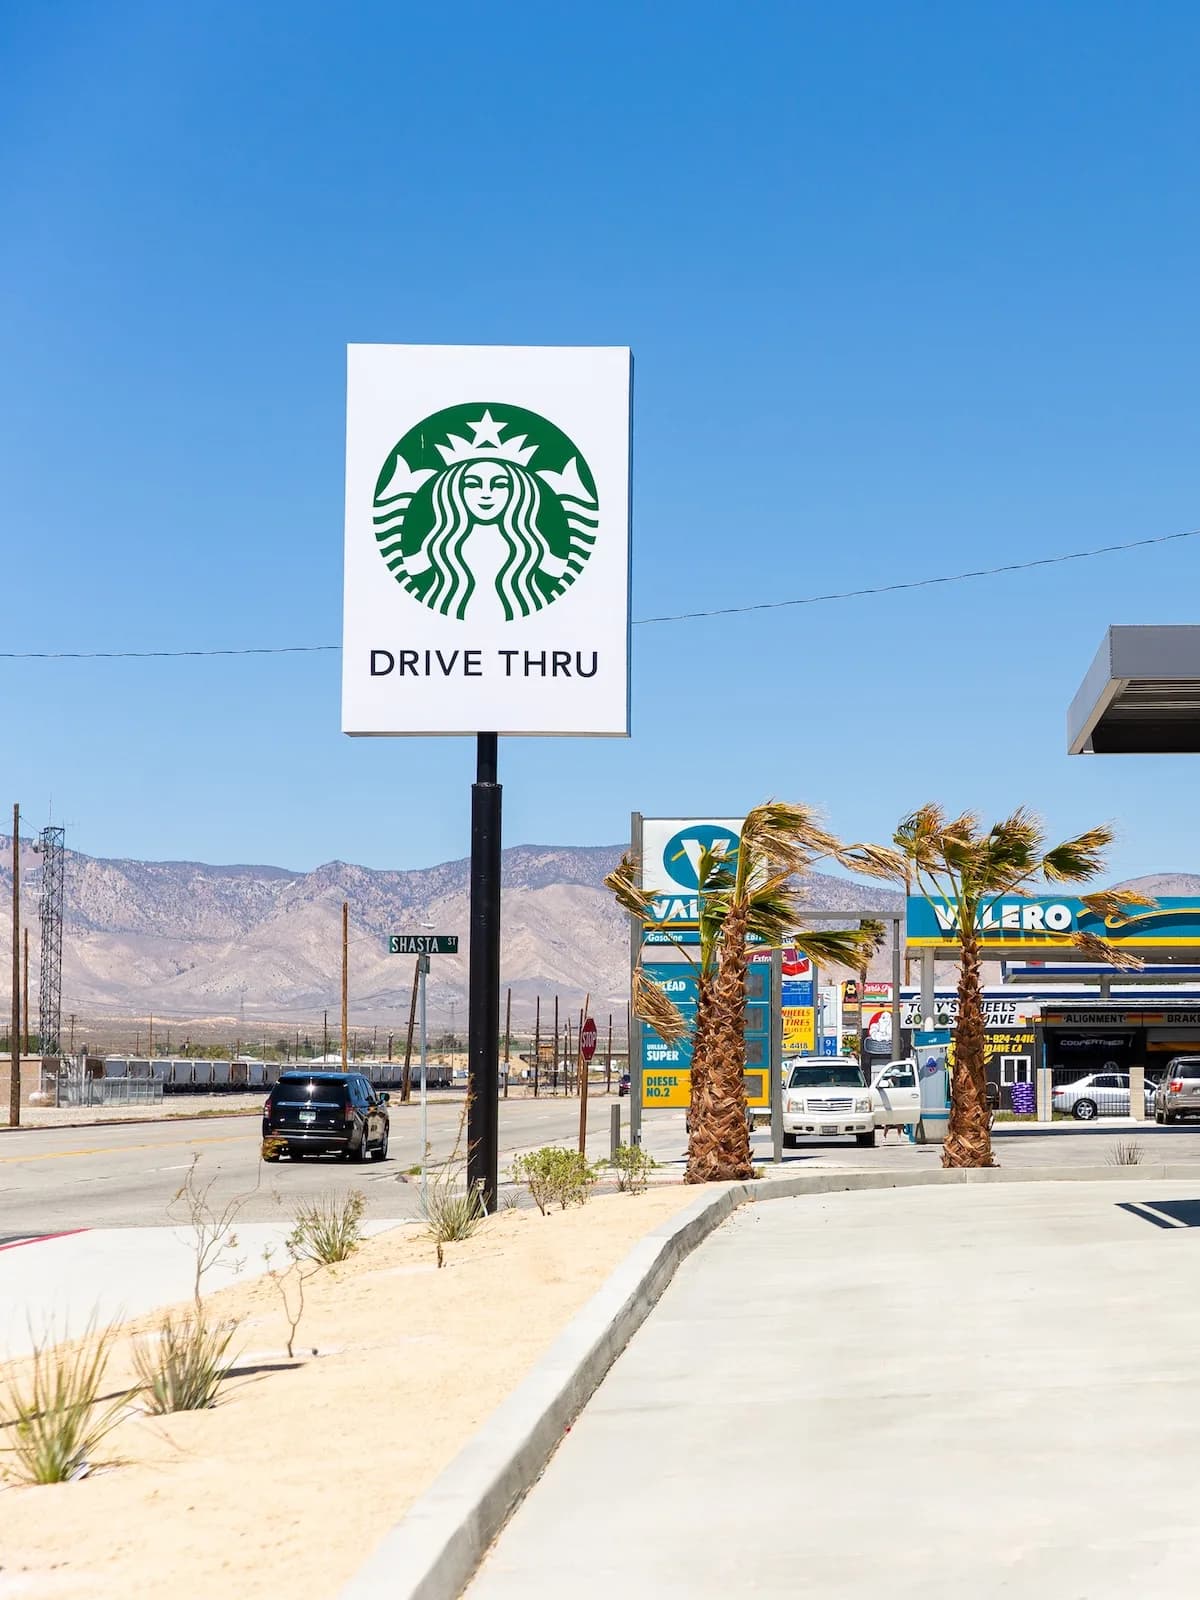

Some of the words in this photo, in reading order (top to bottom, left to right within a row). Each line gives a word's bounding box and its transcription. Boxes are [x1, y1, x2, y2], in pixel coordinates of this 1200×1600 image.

[370, 650, 483, 676] DRIVE
[498, 650, 598, 677] THRU
[934, 904, 1072, 931] VLERO
[391, 937, 439, 953] SHASTA
[447, 937, 456, 946] ST
[908, 1003, 957, 1013] TY'S
[785, 1018, 810, 1026] TIRES
[983, 1014, 1015, 1024] JAVE
[1065, 1014, 1122, 1023] ALIGNMENT
[582, 1031, 596, 1048] STOP
[646, 1050, 679, 1061] SUPER
[646, 1076, 679, 1086] DIESEL
[646, 1087, 670, 1097] NO.2
